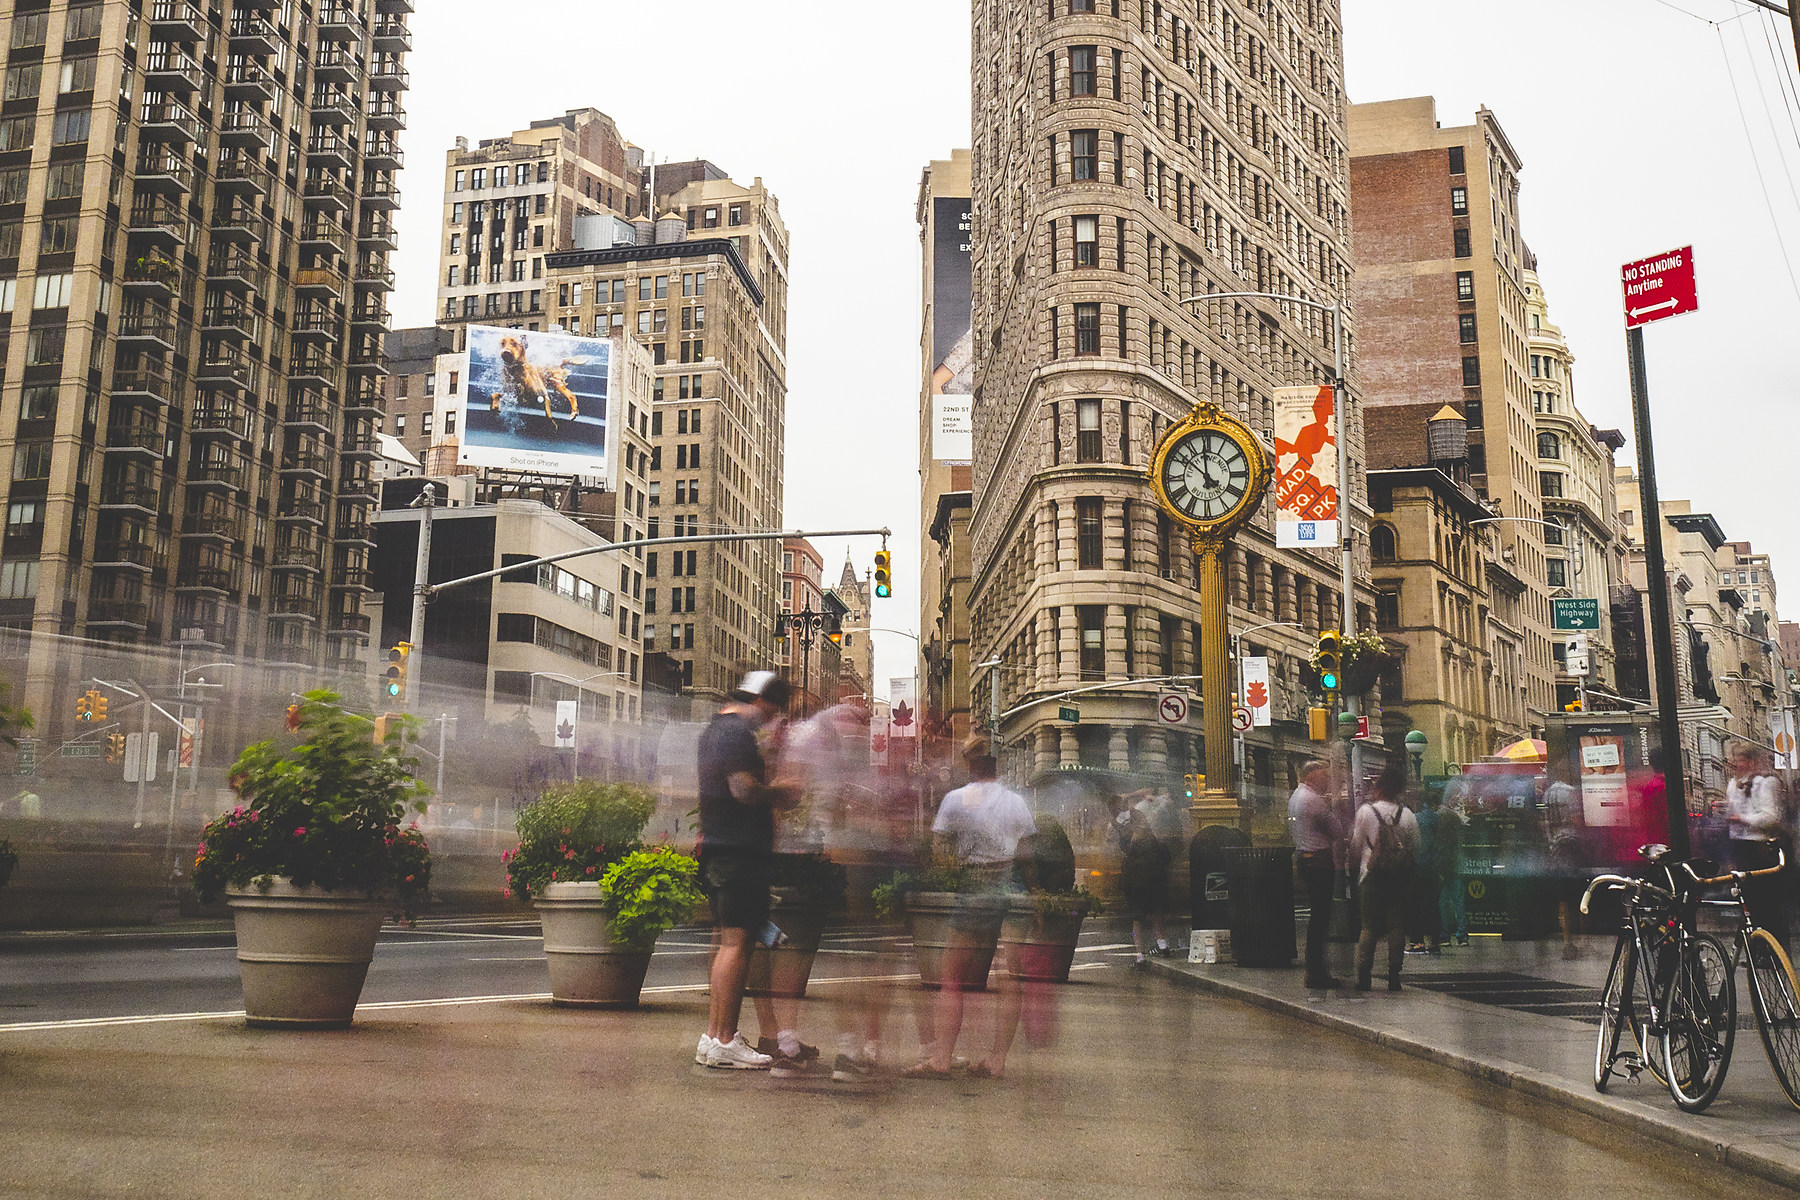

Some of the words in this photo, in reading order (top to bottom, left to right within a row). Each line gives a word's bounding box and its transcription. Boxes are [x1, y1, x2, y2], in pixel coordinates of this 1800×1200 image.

[1625, 267, 1638, 281] NO
[1639, 255, 1682, 278] STANDING
[1627, 277, 1664, 296] Anytime
[510, 456, 526, 465] Shot
[536, 459, 559, 468] iPhone
[1191, 484, 1225, 499] BUILDING
[1312, 495, 1336, 518] PK
[1557, 601, 1577, 609] West
[1579, 601, 1596, 609] Side
[1560, 609, 1594, 618] Highway
[1506, 795, 1526, 809] 18
